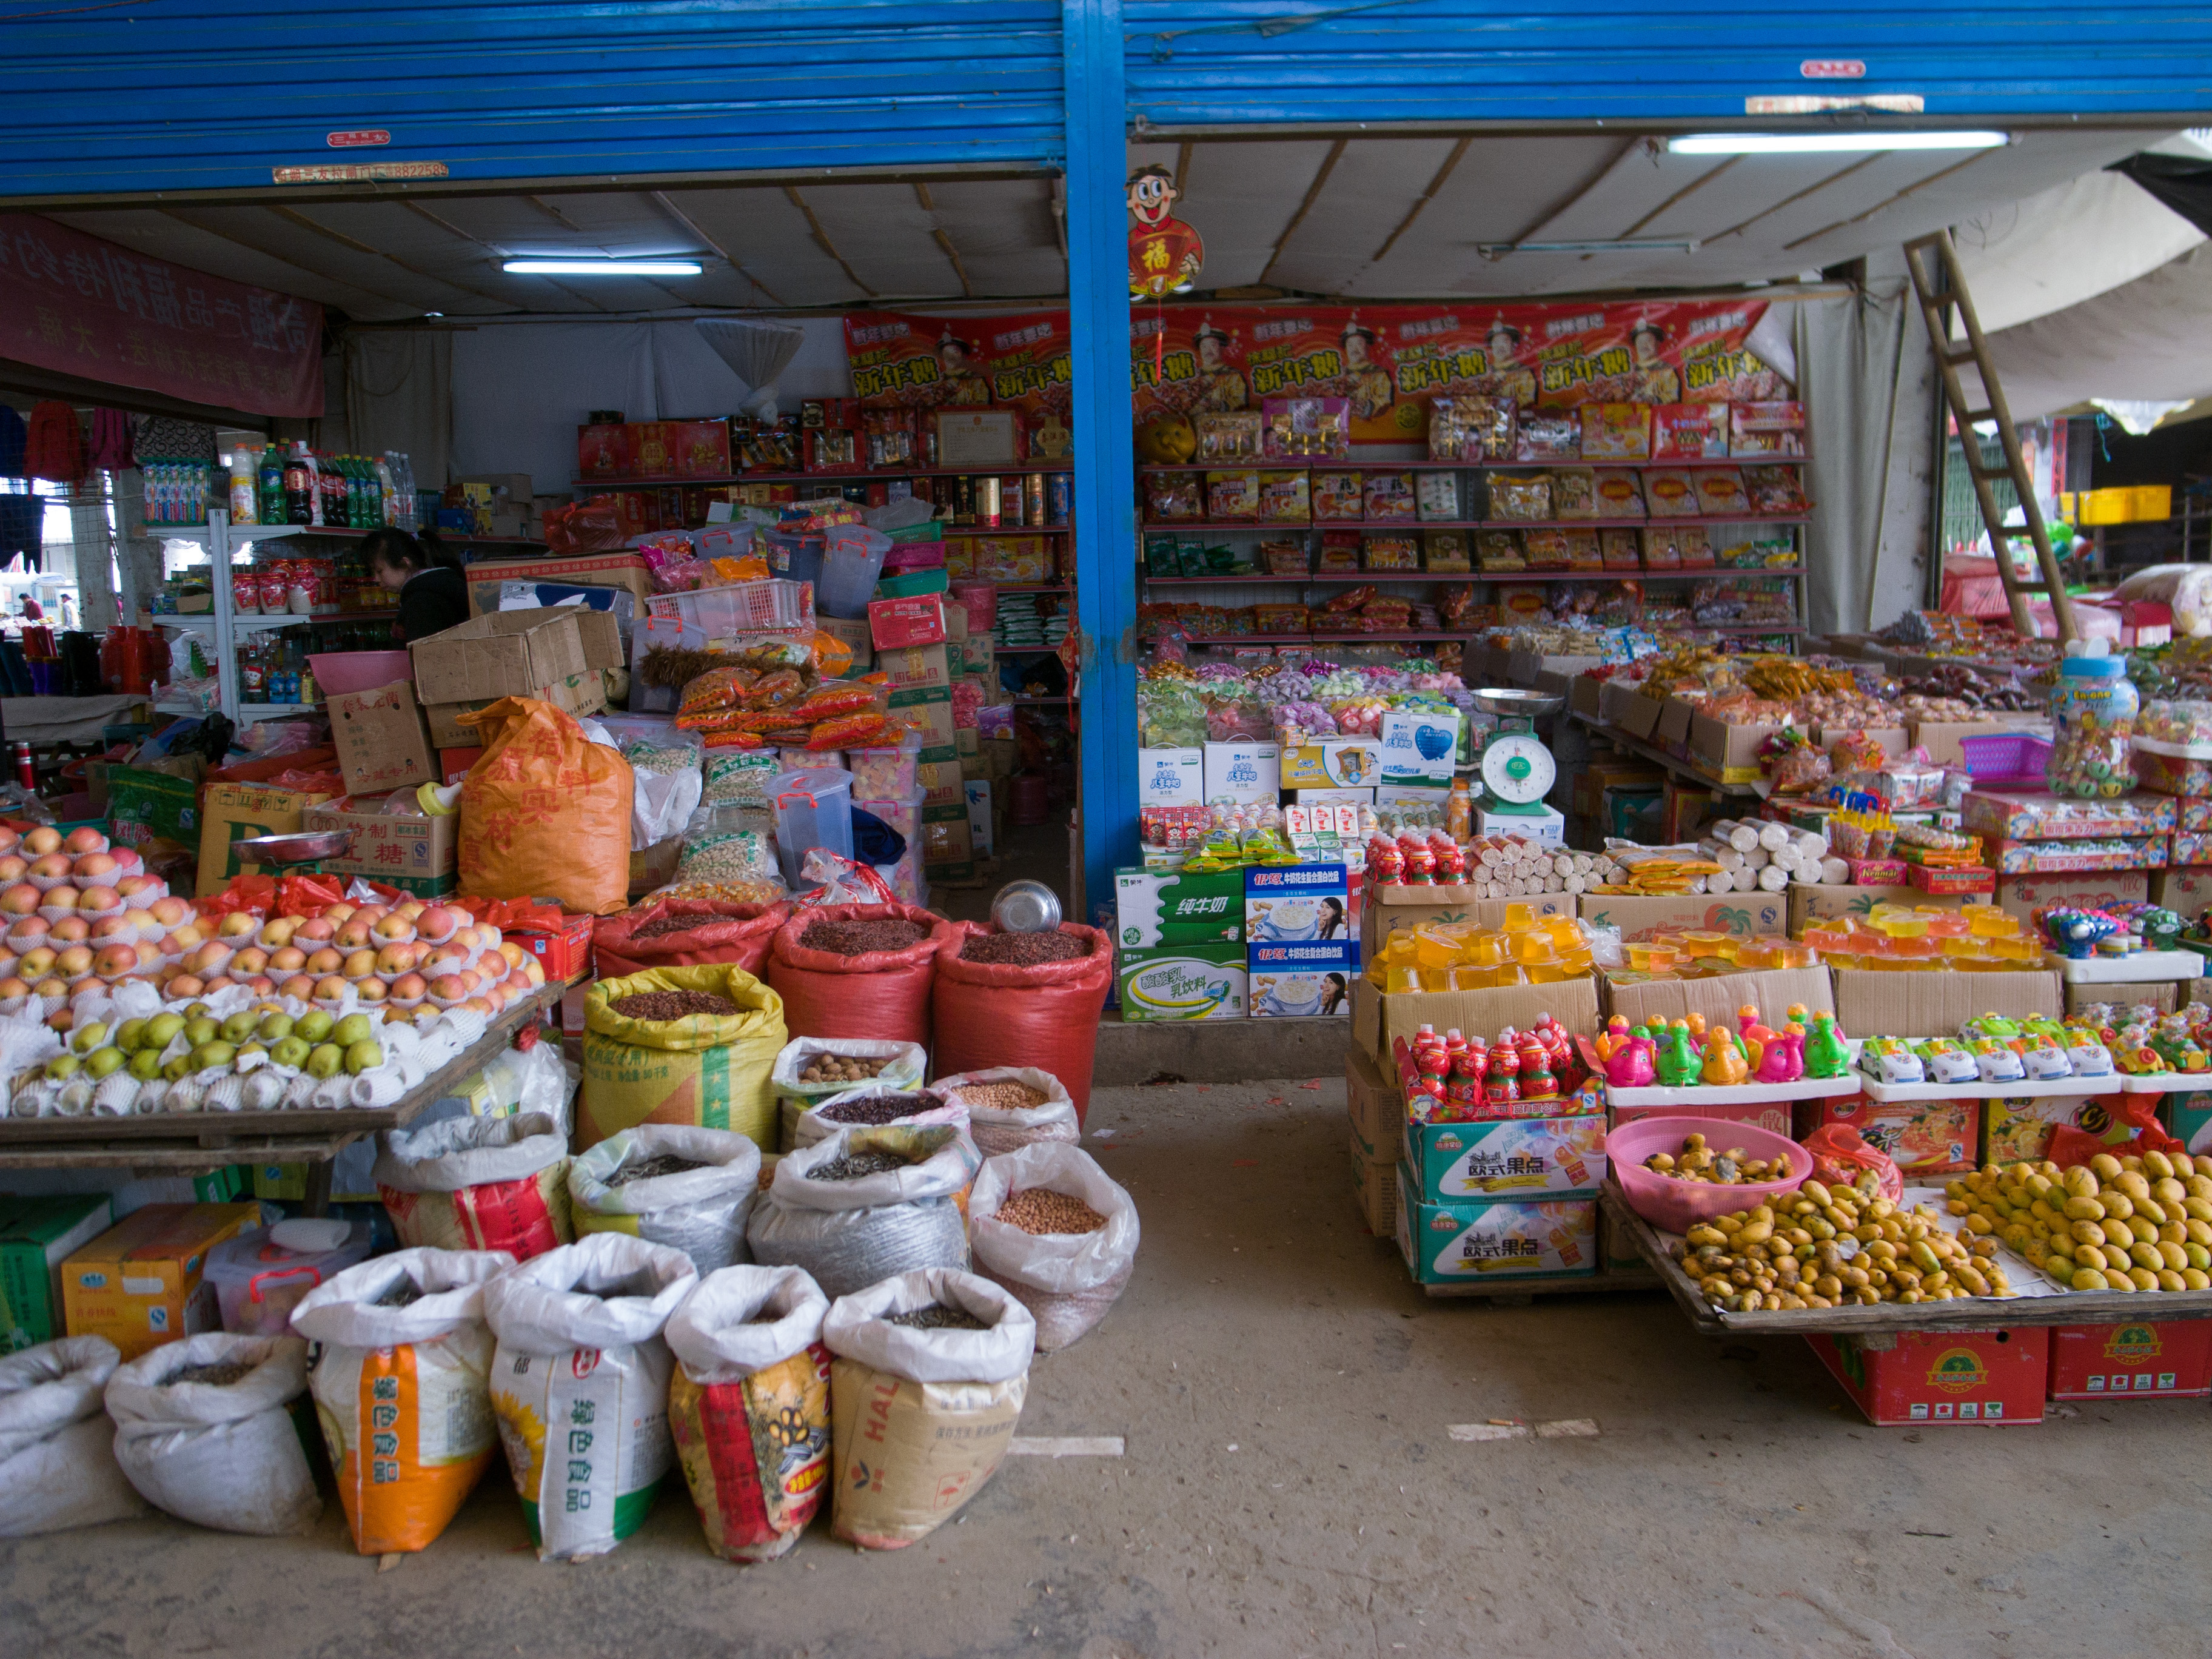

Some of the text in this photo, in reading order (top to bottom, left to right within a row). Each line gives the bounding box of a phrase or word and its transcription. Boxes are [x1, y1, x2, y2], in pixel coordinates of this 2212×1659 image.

[395, 163, 448, 178] 8822589
[1142, 238, 1170, 272] 福
[853, 356, 939, 397] 新年糖
[1131, 352, 1196, 391] 年糖
[1252, 350, 1341, 394] 新年糖
[1399, 349, 1486, 393] 新年糖
[1542, 347, 1631, 392] 新年糖
[87, 592, 93, 605] 5
[1150, 779, 1181, 789] 儿童牛奶
[1226, 771, 1258, 782] 儿童牛奶
[347, 822, 388, 839] 特制
[1254, 871, 1339, 886] 银鹭 牛奶花生复合蛋白饮品
[1175, 896, 1230, 915] 纯牛奶
[1258, 946, 1343, 961] 银鹭 牛奶花生复合蛋白饮品
[1141, 967, 1186, 990] 酸酸乳
[1170, 975, 1207, 999] 乳饮料
[1468, 1156, 1544, 1176] 欧式果点
[1463, 1238, 1538, 1258] 欧式果点
[864, 1381, 900, 1443] HAL
[372, 1375, 400, 1486] 绿色食品
[565, 1398, 595, 1513] 绿色食品
